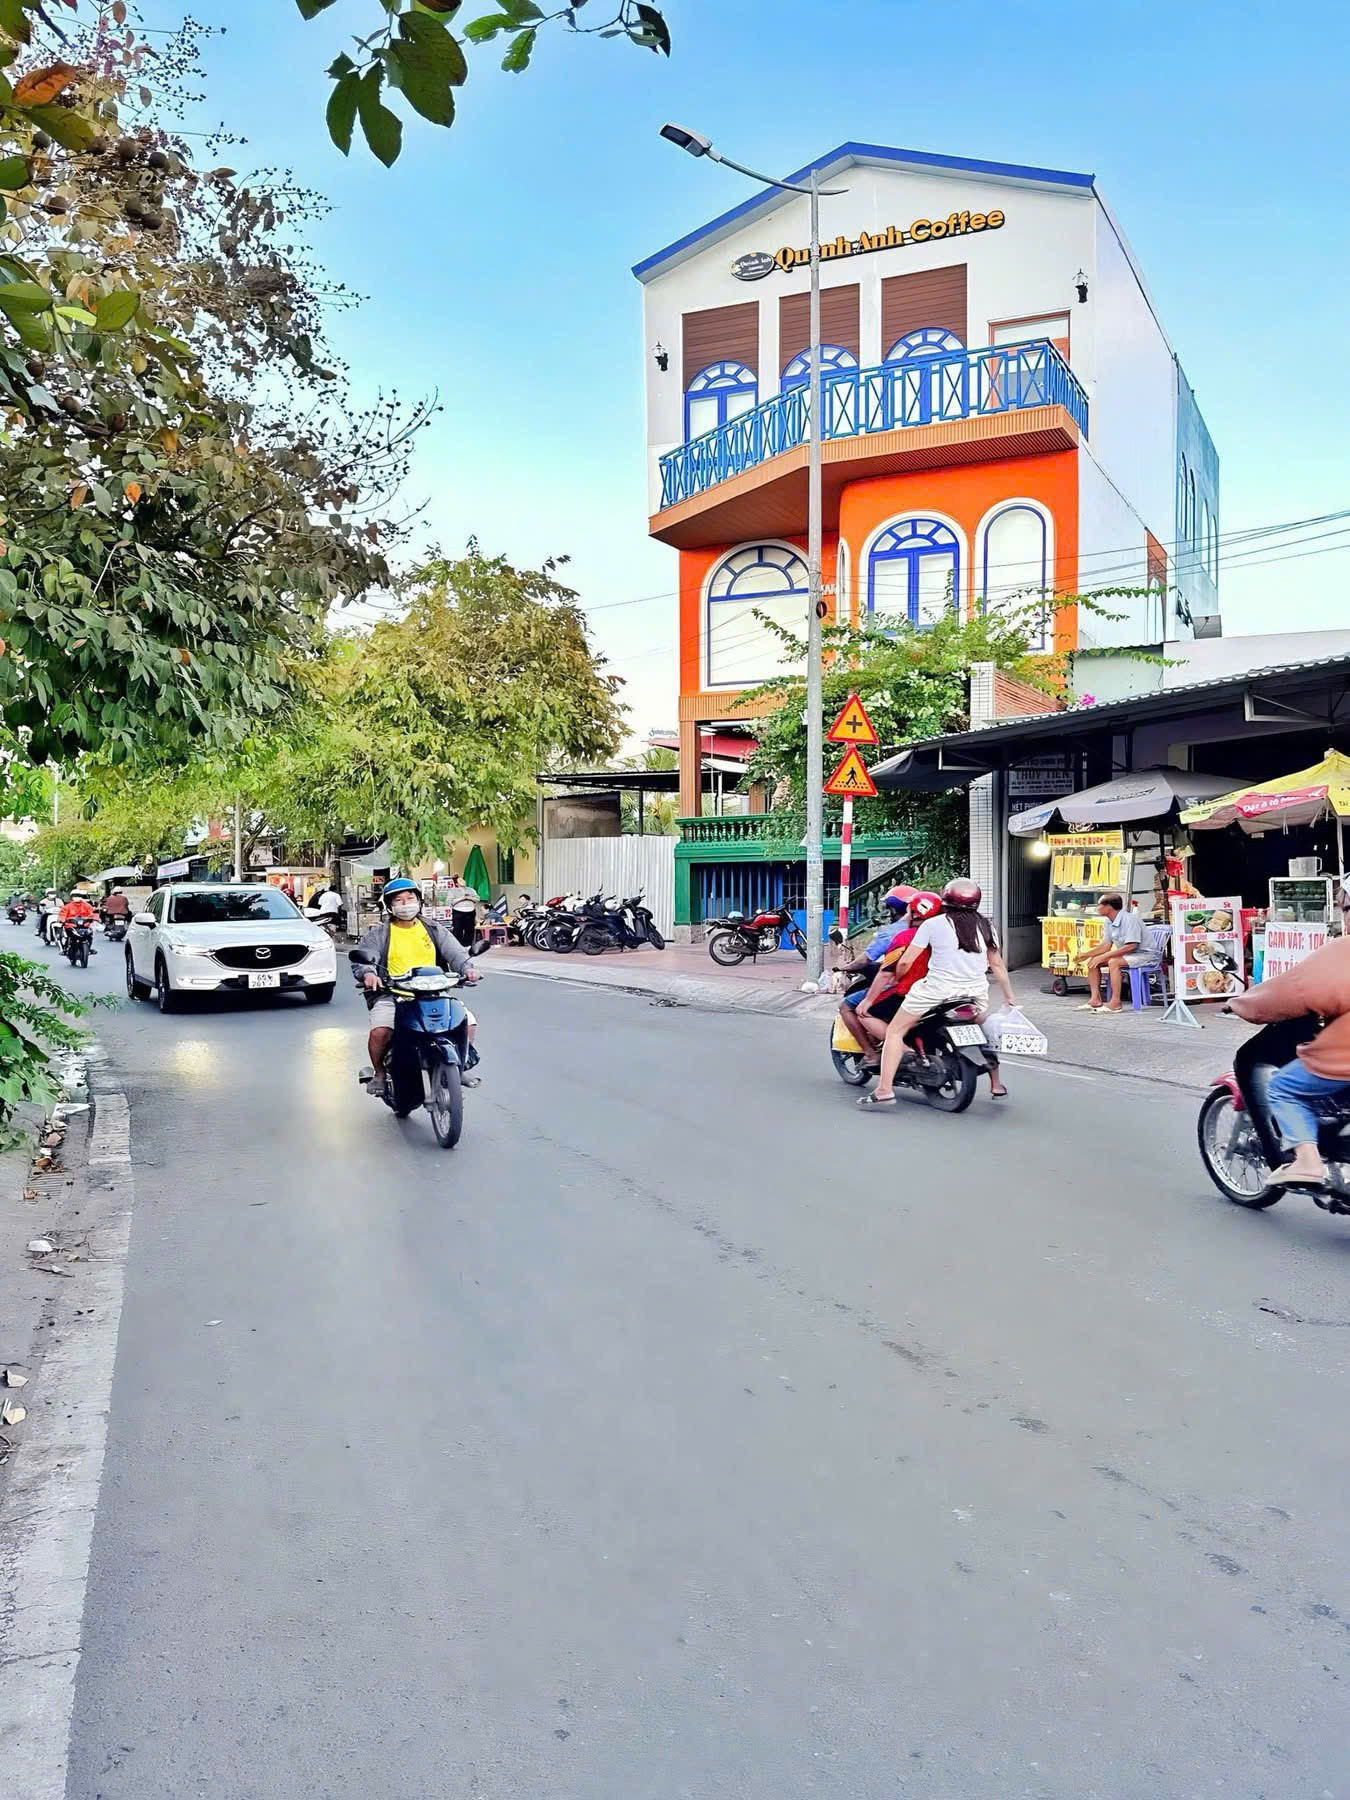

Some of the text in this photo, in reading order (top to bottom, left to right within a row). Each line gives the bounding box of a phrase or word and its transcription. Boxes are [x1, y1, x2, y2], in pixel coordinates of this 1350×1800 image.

[774, 208, 1005, 273] Qunh Anh Coffee
[1048, 936, 1071, 953] 5K
[1268, 931, 1286, 948] CAM
